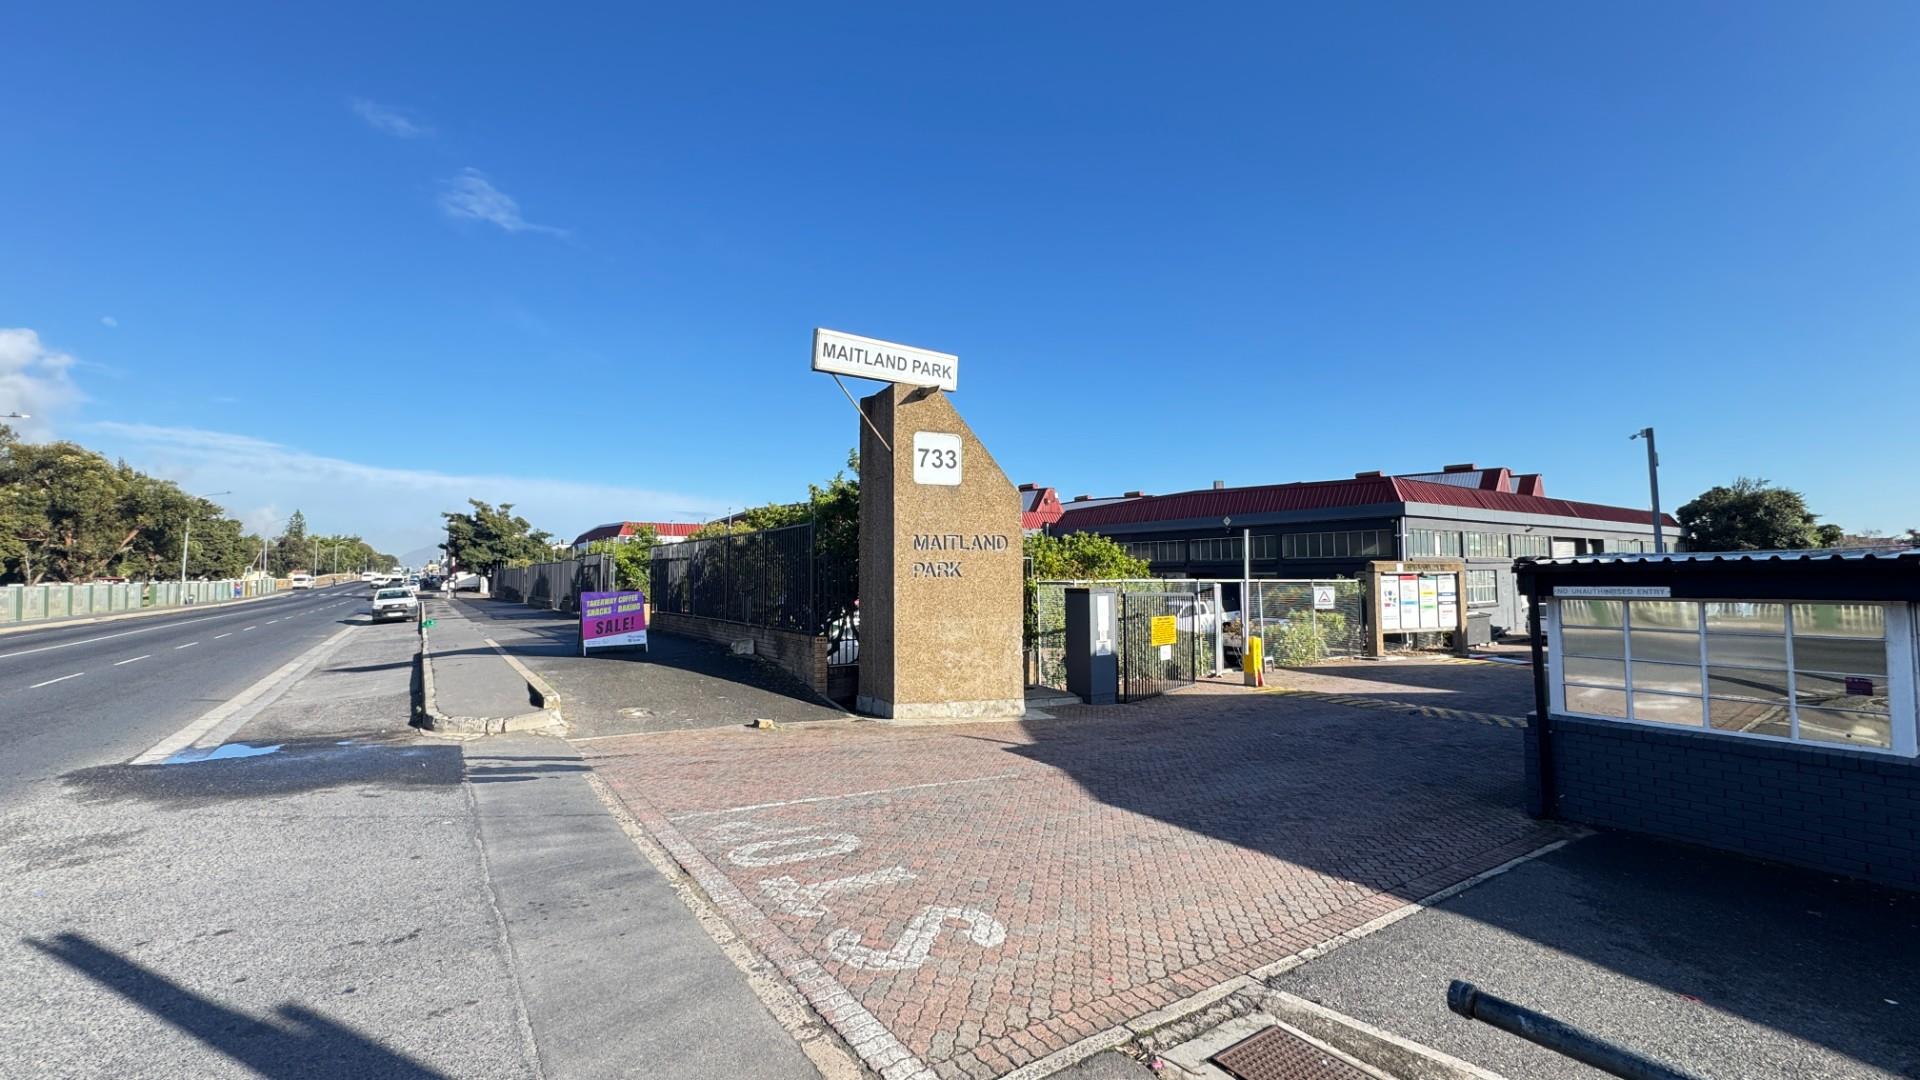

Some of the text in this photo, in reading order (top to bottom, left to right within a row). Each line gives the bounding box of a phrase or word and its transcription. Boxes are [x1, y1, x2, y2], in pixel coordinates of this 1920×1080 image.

[822, 342, 952, 379] MAITLAND PARK
[918, 448, 957, 469] 733
[913, 534, 1009, 551] MAITLAND
[913, 561, 962, 578] PARK
[596, 616, 634, 634] SALE!
